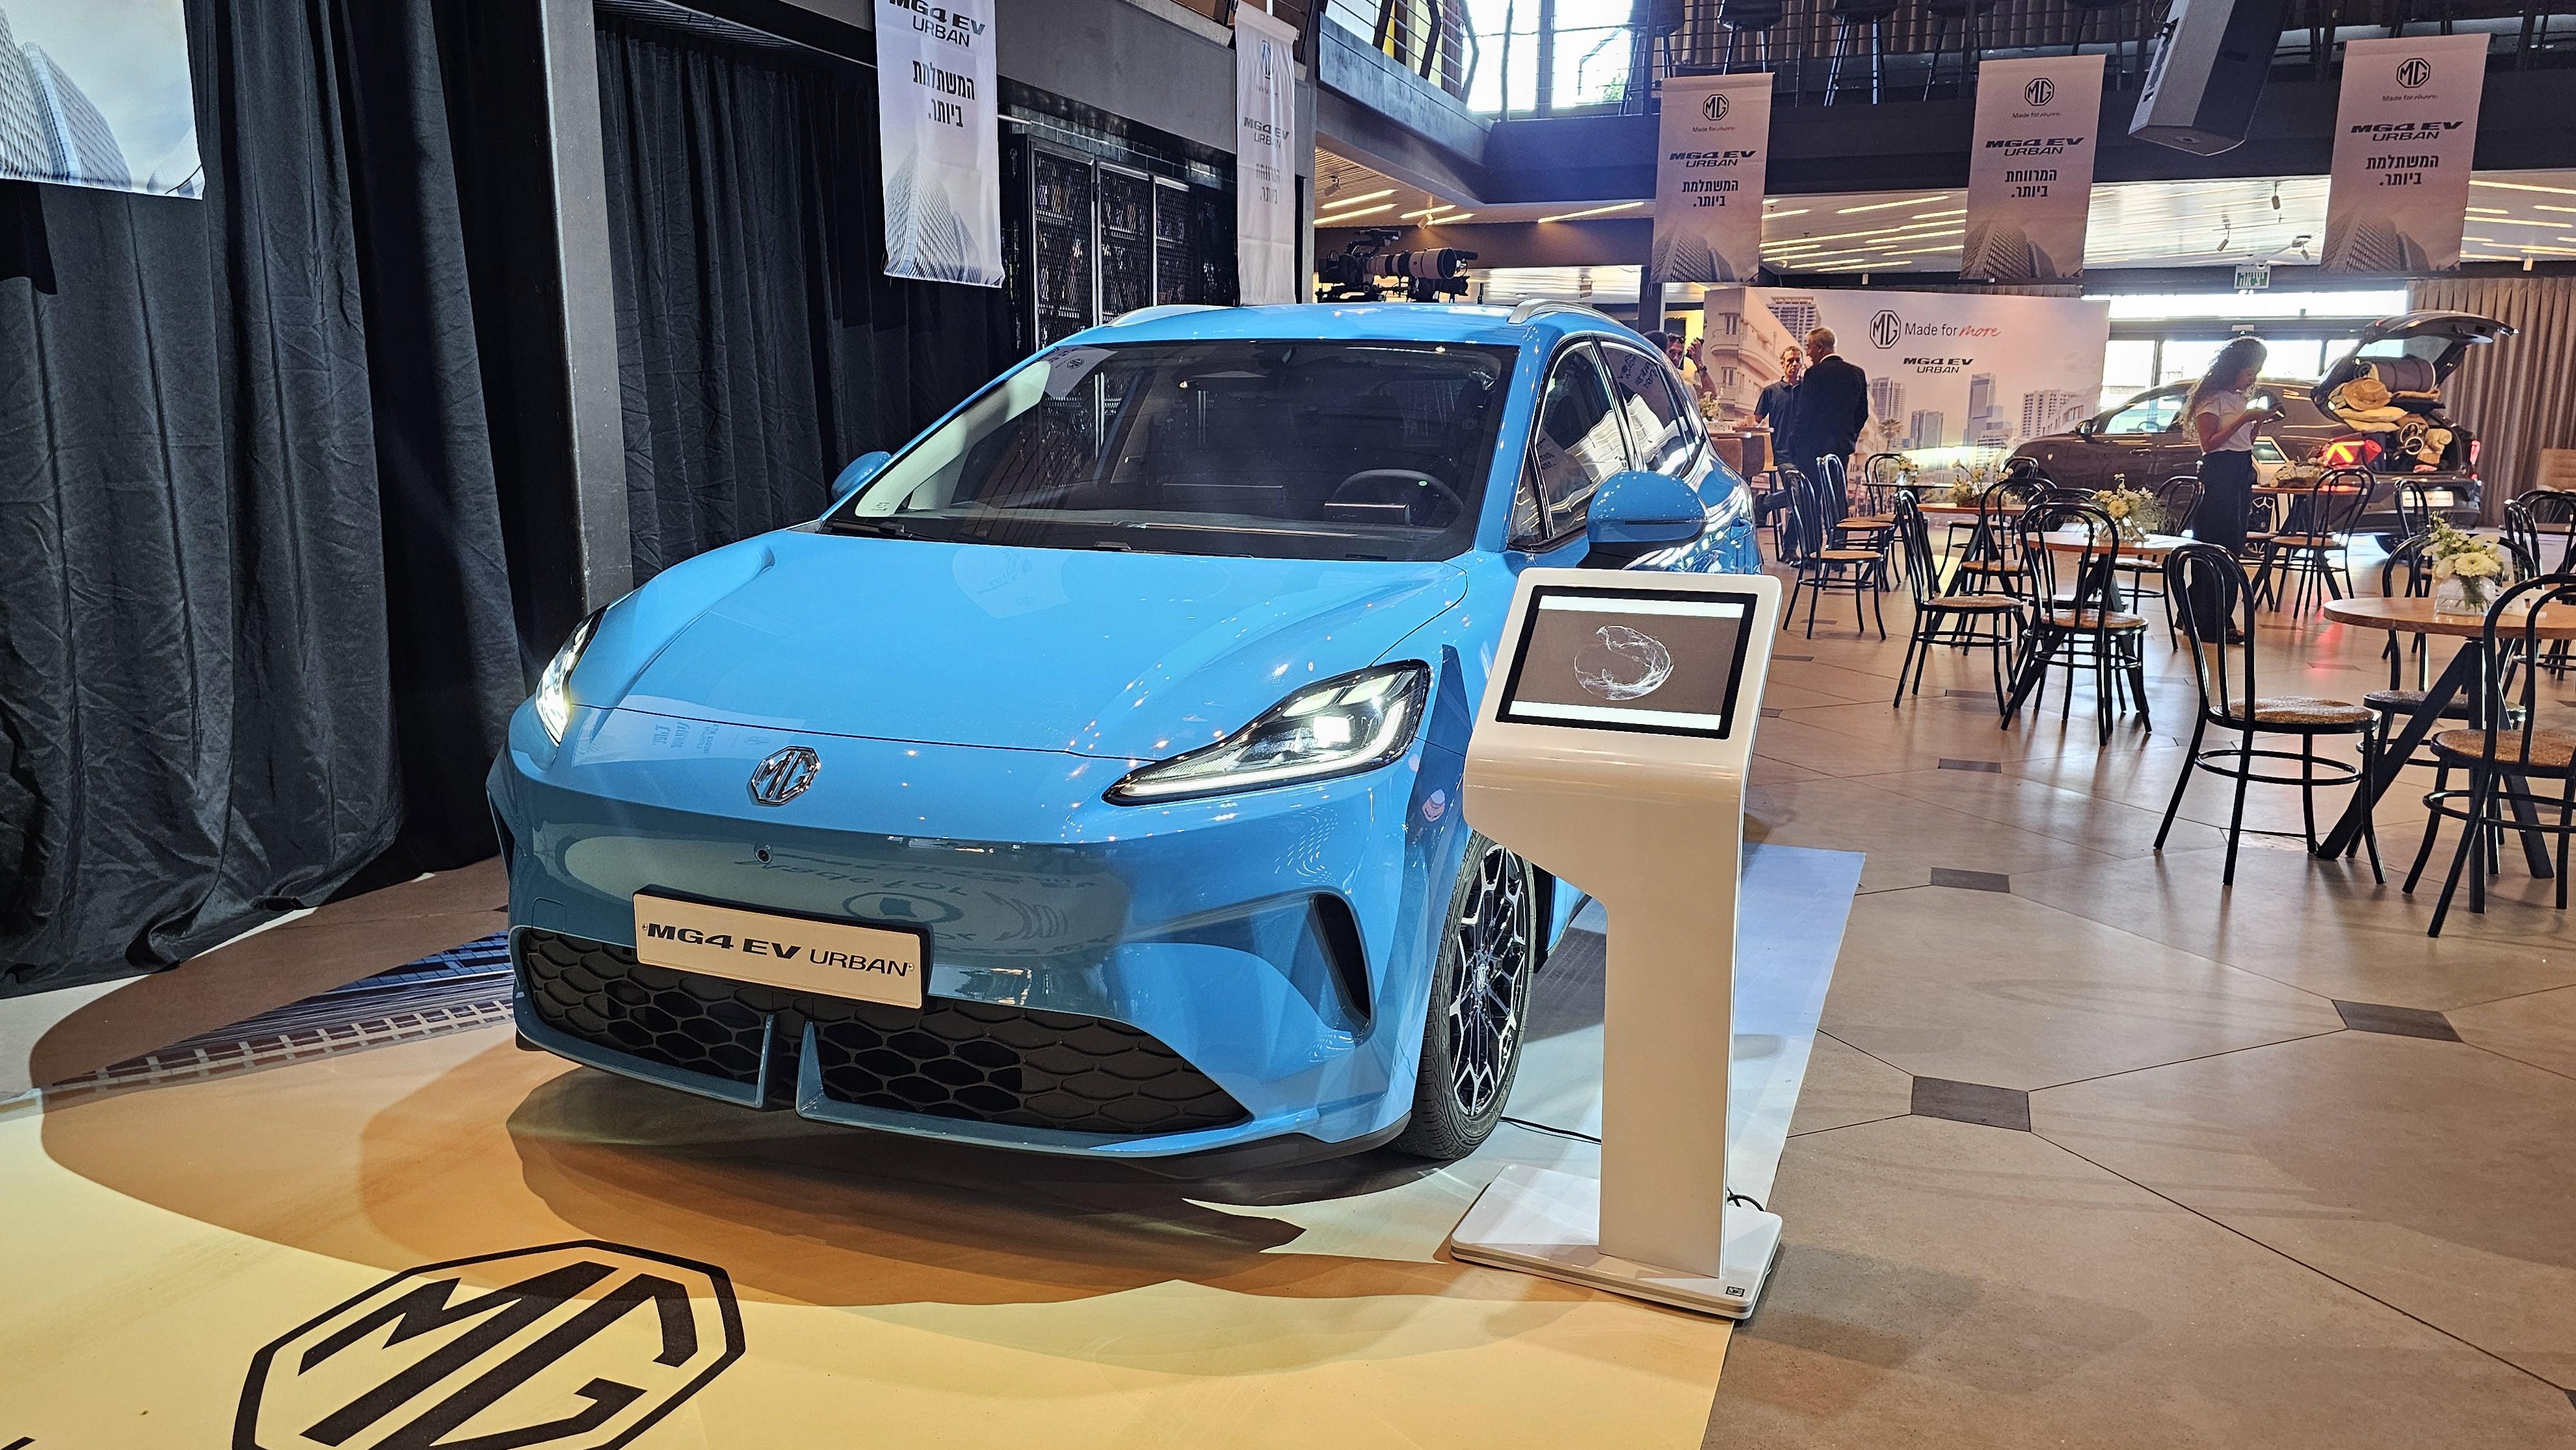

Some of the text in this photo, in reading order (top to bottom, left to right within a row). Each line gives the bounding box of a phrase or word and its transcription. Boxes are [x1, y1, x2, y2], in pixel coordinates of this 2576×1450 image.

[913, 15, 970, 47] URBAN
[952, 13, 985, 35] EV
[913, 60, 975, 100] המשתלמת
[2400, 61, 2428, 85] MG
[2027, 81, 2052, 103] MG
[928, 98, 963, 127] ביותר.
[1705, 97, 1726, 118] MG
[1244, 117, 1290, 140] MG4 EV
[2351, 121, 2464, 133] MG4 EV
[1254, 132, 1281, 149] URBN
[1986, 137, 2084, 148] MG4 EV
[2372, 132, 2439, 141] URBAN
[1670, 151, 1719, 160] MG4
[2004, 147, 2063, 156] URBAN
[2366, 155, 2439, 170] המשתלמת
[2005, 170, 2057, 182] המרווחת
[2379, 173, 2422, 186] ביותר.
[1682, 179, 1739, 192] המשתלמת
[2011, 186, 2048, 197] ביותר.
[1693, 196, 1726, 207] ביותר.
[1873, 314, 1898, 345] MG
[1905, 323, 2001, 337] Made for more
[754, 749, 815, 800] MG
[648, 923, 908, 977] MG4 EV URBAN
[298, 1260, 699, 1450] MG
